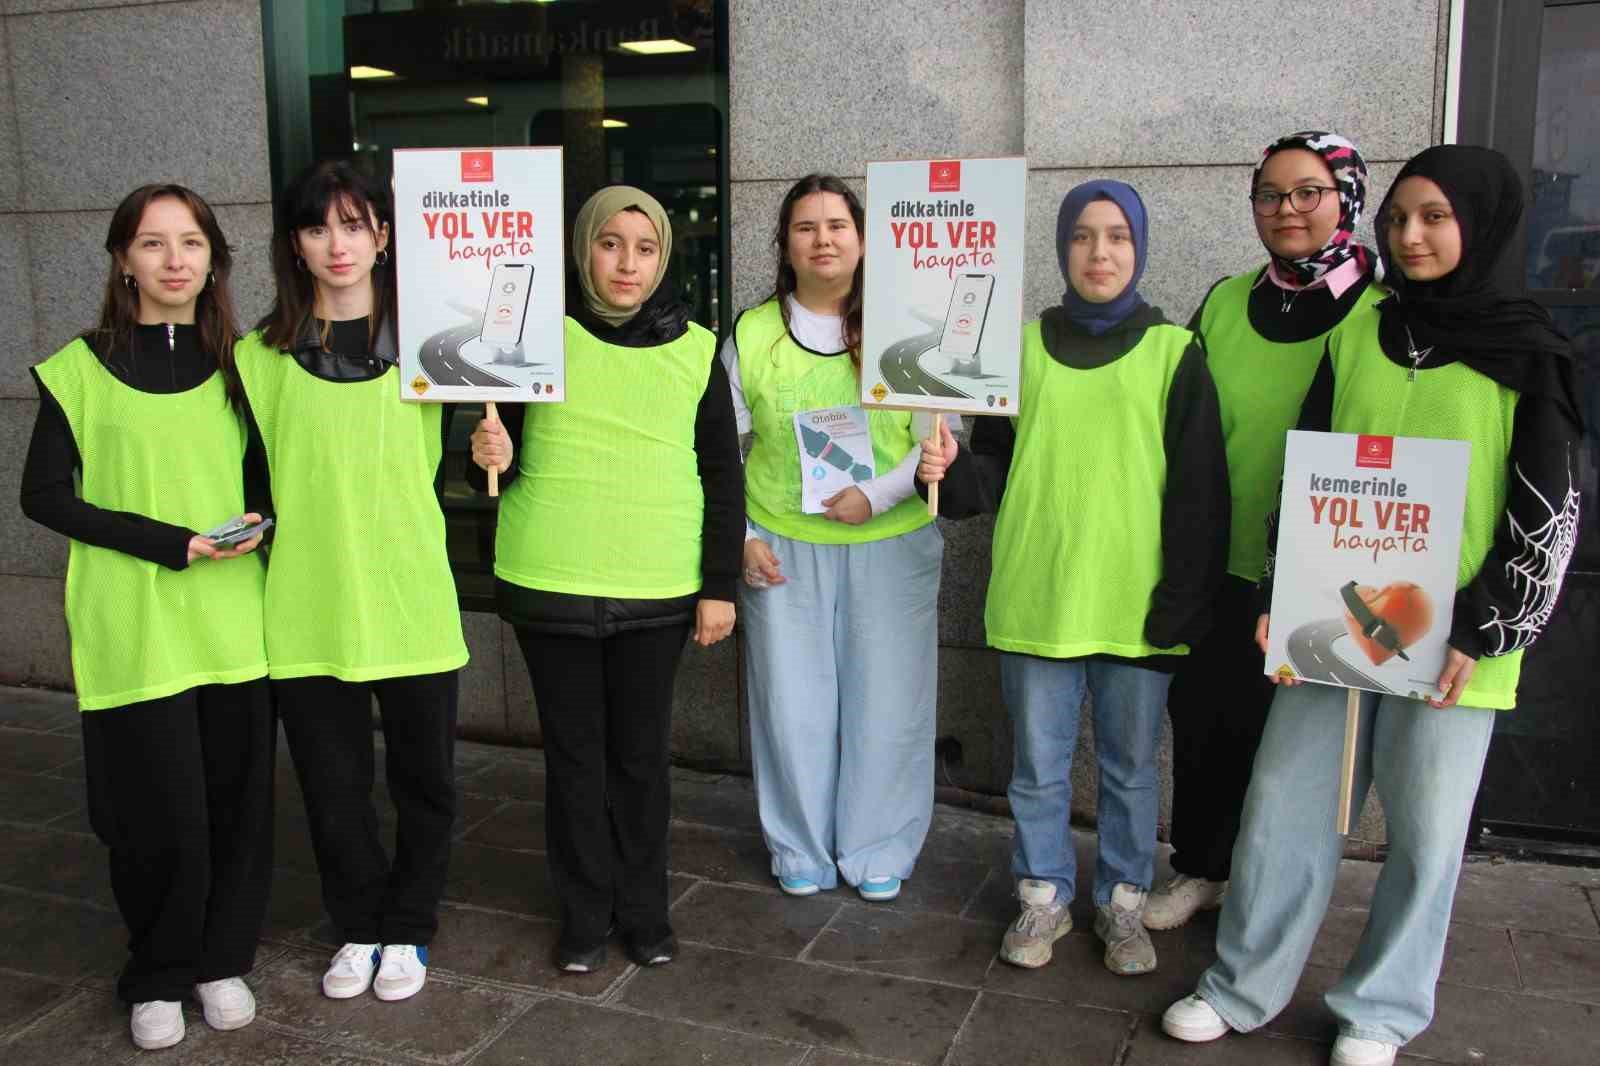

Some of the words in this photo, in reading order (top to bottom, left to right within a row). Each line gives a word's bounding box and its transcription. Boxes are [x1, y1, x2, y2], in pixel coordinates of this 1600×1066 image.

[422, 190, 510, 208] dikkatinle
[890, 200, 975, 218] dikkatinle
[423, 212, 474, 239] YOL
[482, 211, 534, 238] VER
[891, 221, 938, 249] YOL
[947, 221, 996, 248] VER
[448, 232, 534, 269] hayata
[913, 240, 995, 278] hayata
[1310, 473, 1408, 497] kemerinle
[1310, 496, 1363, 529] YOL
[1374, 500, 1431, 534] VER
[1333, 524, 1428, 562] hayata
